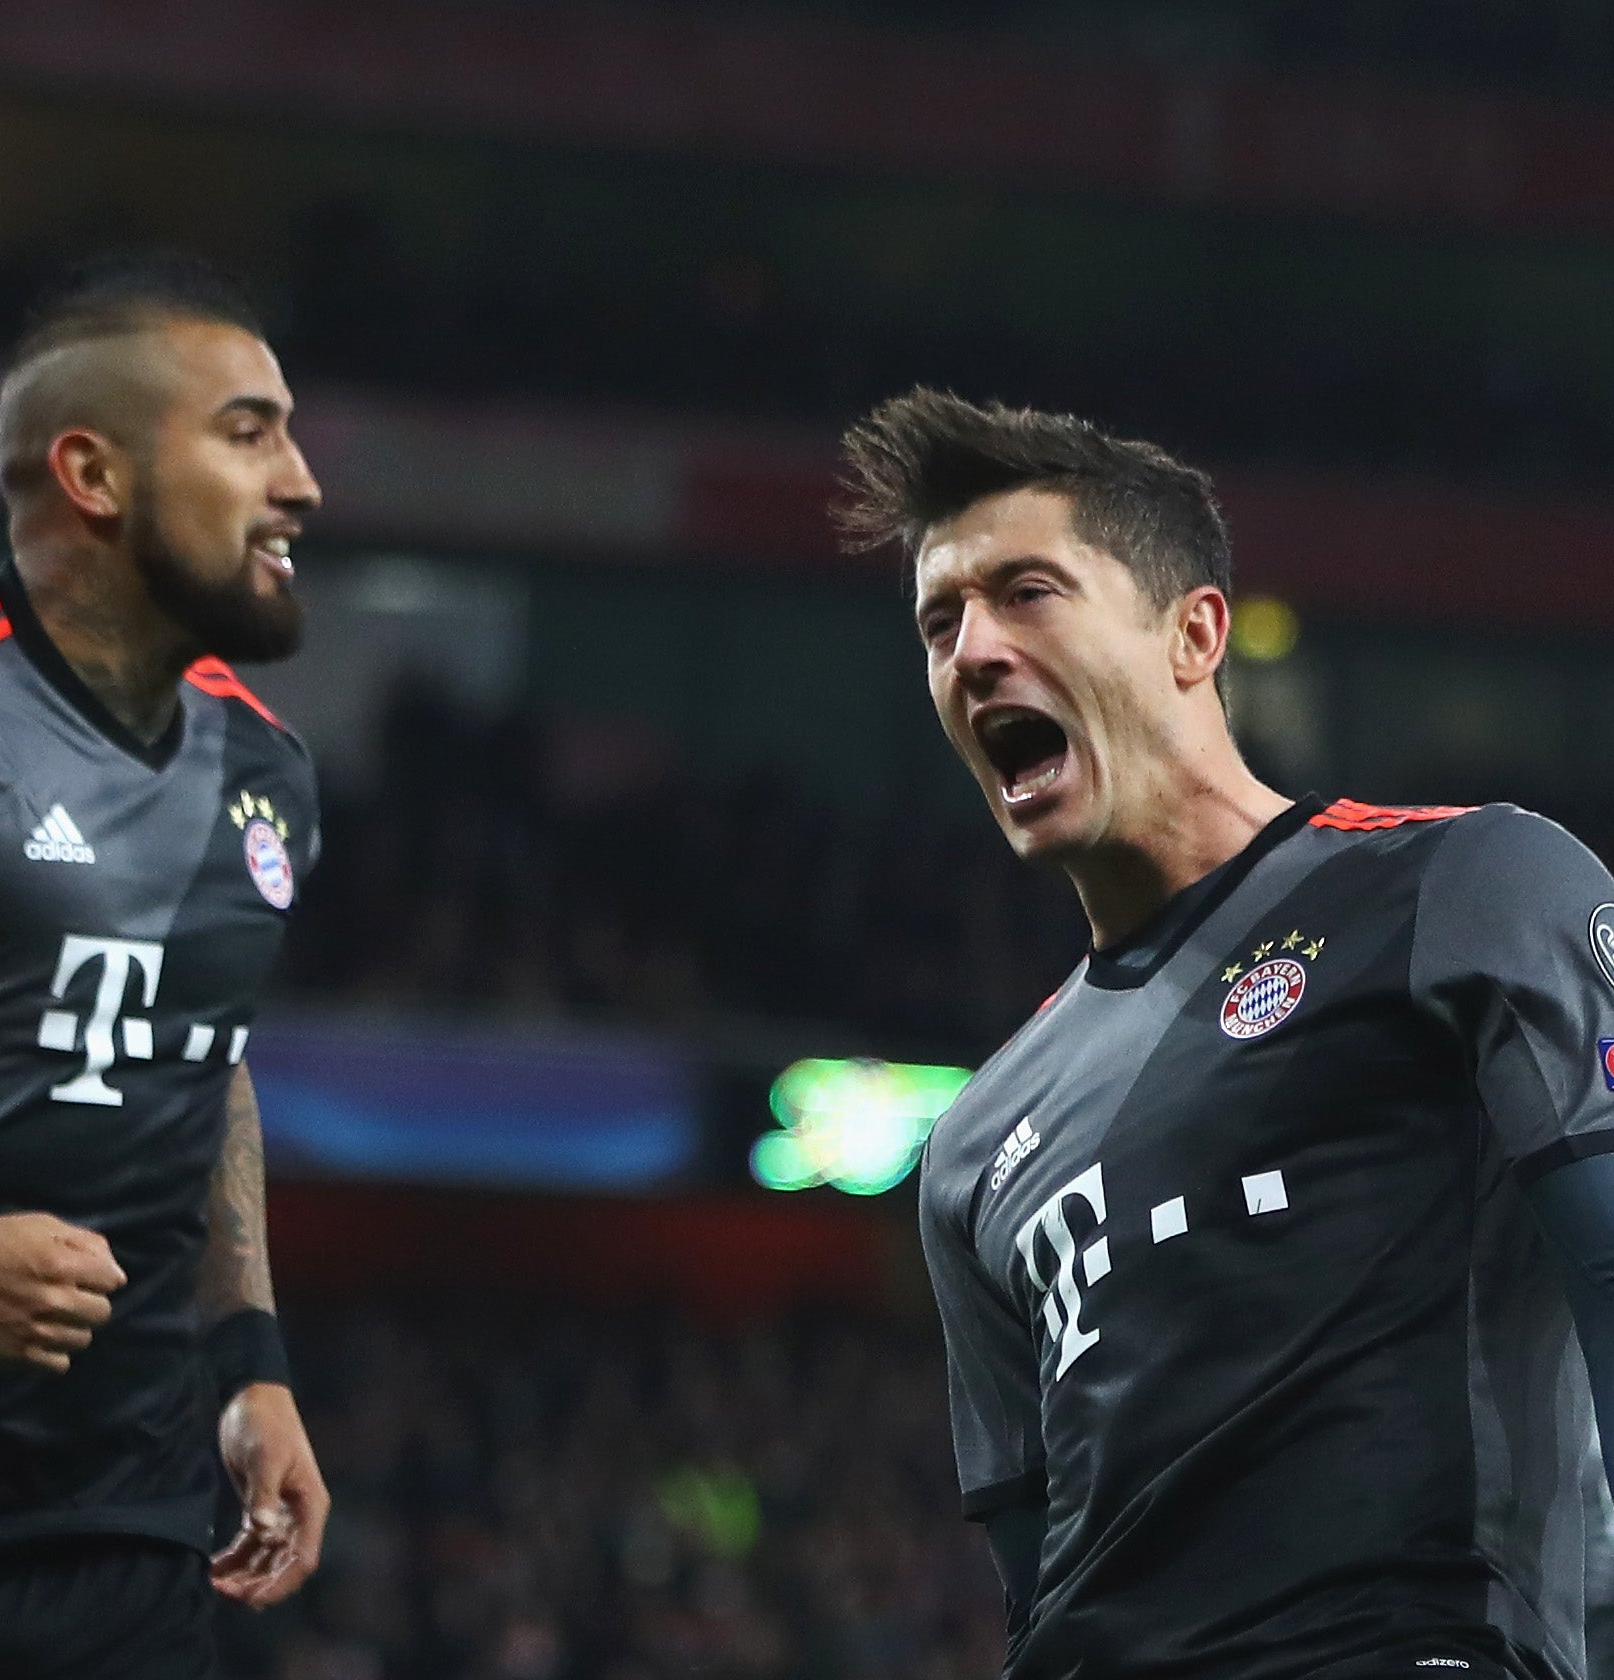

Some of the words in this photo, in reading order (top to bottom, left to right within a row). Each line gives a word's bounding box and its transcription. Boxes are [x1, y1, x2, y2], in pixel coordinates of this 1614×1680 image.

[23, 841, 96, 864] adidas
[1229, 984, 1248, 1003] FC
[1250, 963, 1302, 987] BAYERN
[990, 1132, 1041, 1190] adidas
[1415, 1657, 1470, 1669] adizero
